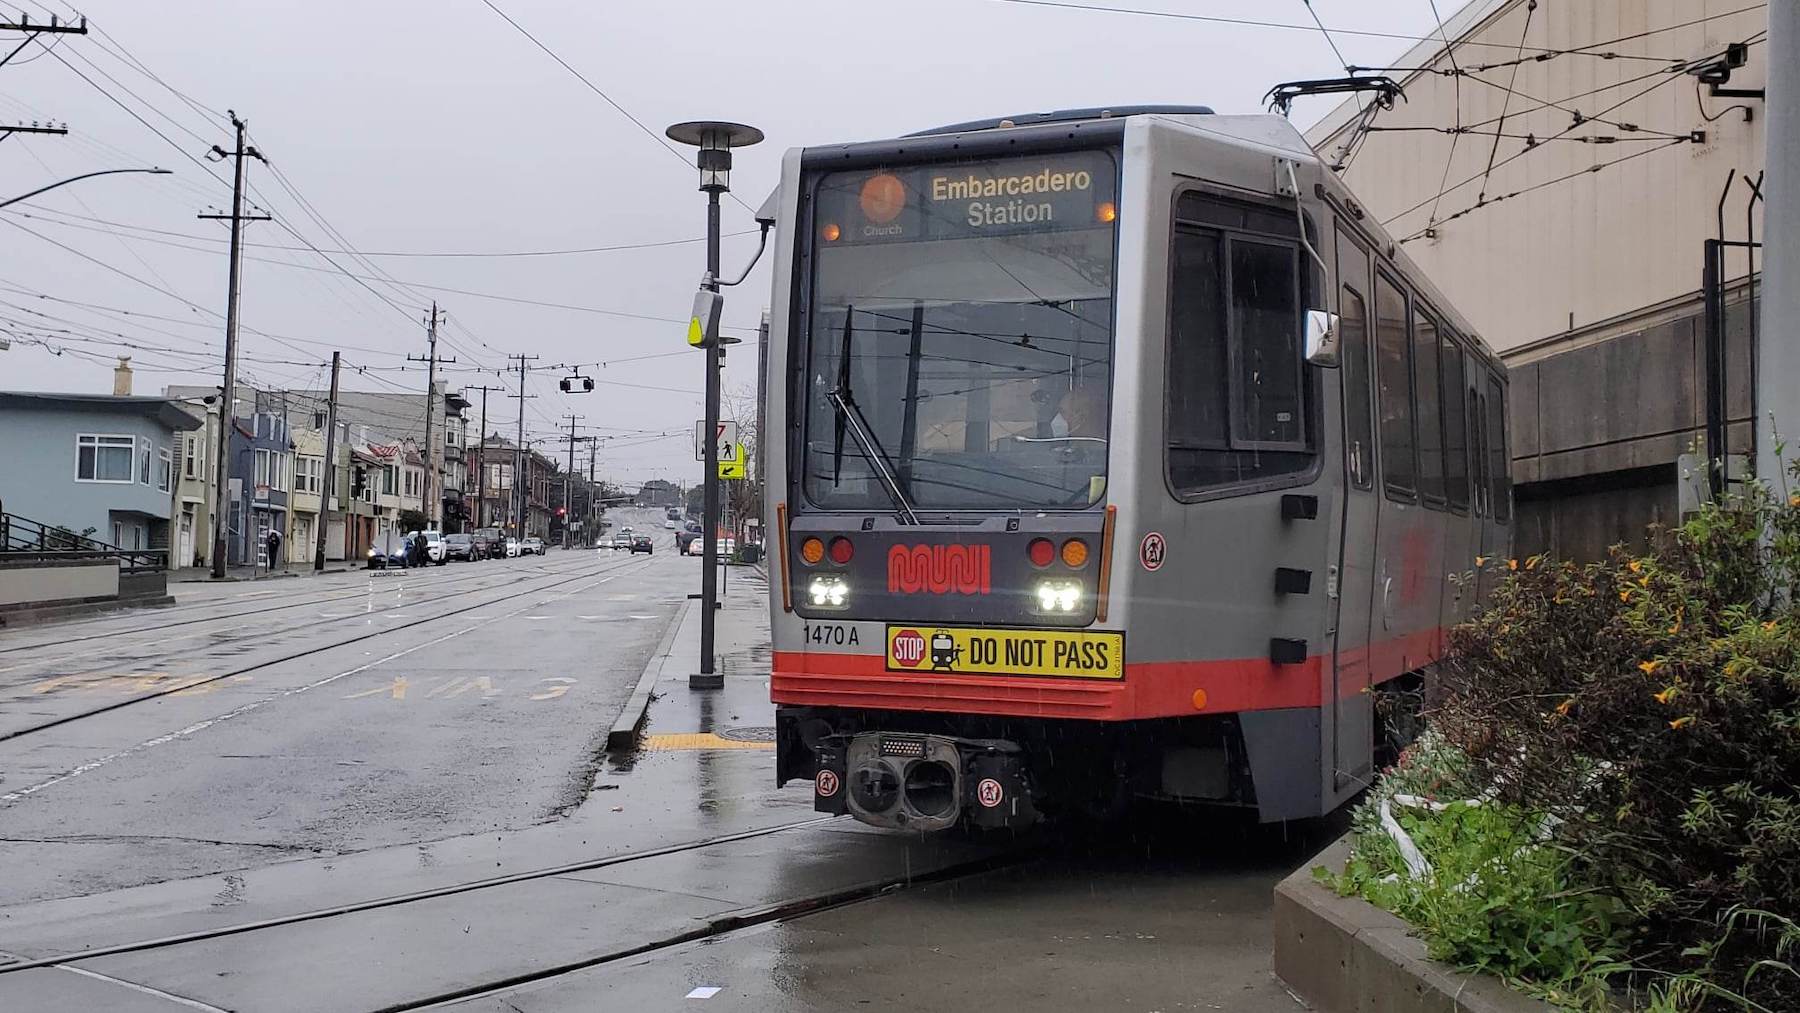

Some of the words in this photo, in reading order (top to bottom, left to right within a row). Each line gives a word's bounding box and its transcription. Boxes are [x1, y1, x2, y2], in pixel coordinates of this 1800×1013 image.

[932, 169, 1090, 201] Embarcadero
[967, 199, 1053, 227] Station
[864, 224, 903, 236] Church
[895, 636, 925, 660] STOP
[970, 637, 997, 665] DO
[1005, 638, 1047, 667] NOT
[1054, 640, 1108, 670] PASS
